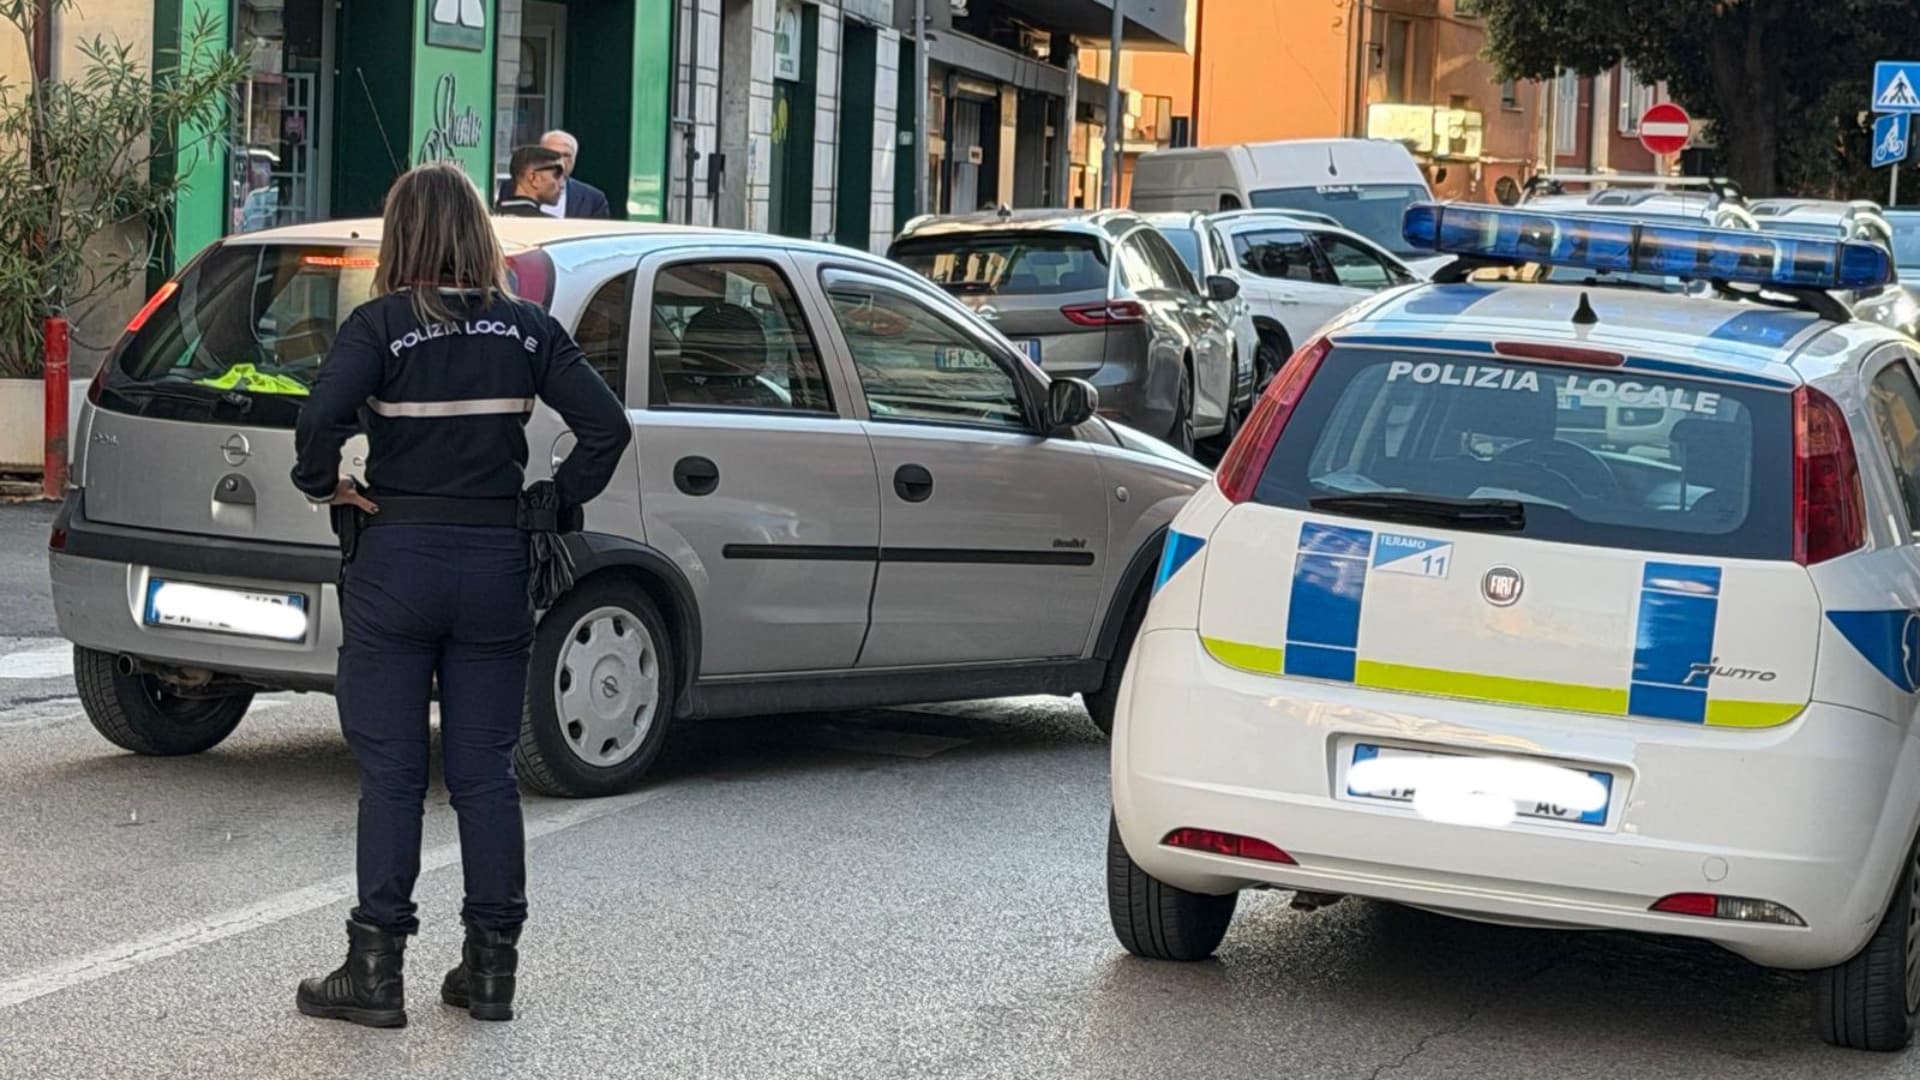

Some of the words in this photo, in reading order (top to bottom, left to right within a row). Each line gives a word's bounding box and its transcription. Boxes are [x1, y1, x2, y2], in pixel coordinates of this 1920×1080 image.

[390, 321, 462, 357] POLIZIA
[465, 319, 538, 353] LOCAE
[1387, 361, 1539, 392] POLIZIA
[1566, 375, 1721, 414] LOCALE
[1380, 535, 1426, 549] TERAMO
[1422, 555, 1446, 576] 11
[1490, 575, 1516, 595] FIAT
